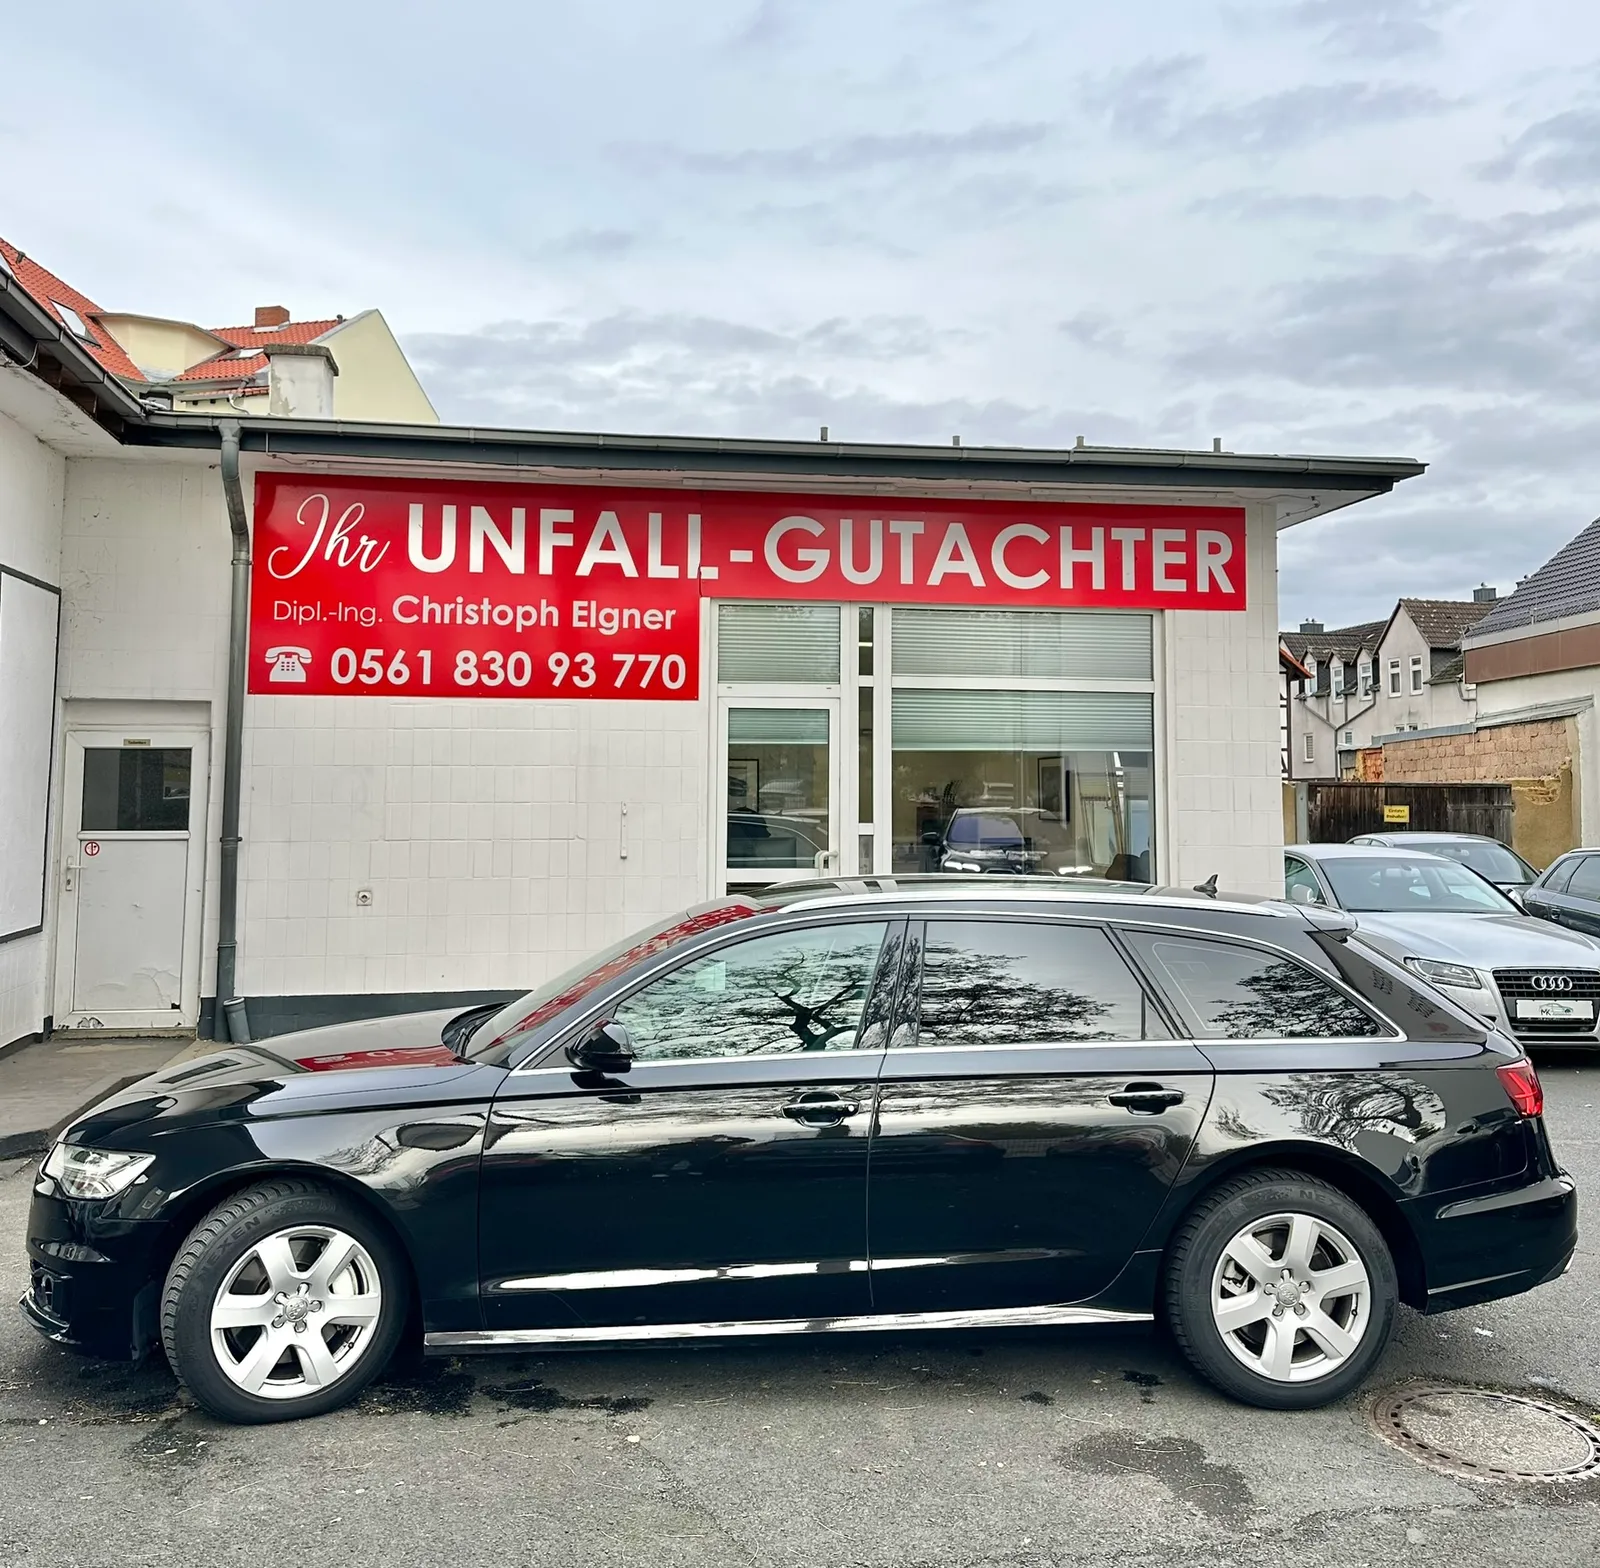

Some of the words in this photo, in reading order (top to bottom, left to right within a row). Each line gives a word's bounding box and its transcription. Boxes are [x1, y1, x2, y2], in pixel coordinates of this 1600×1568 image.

[268, 493, 391, 580] Ihr
[273, 600, 383, 627] Dipl.-Ing.
[392, 595, 559, 633] Christoph
[572, 599, 677, 636] Elgner
[330, 648, 432, 685] 0561
[453, 650, 532, 687] 830
[547, 652, 597, 688] 93
[612, 653, 686, 690] 770
